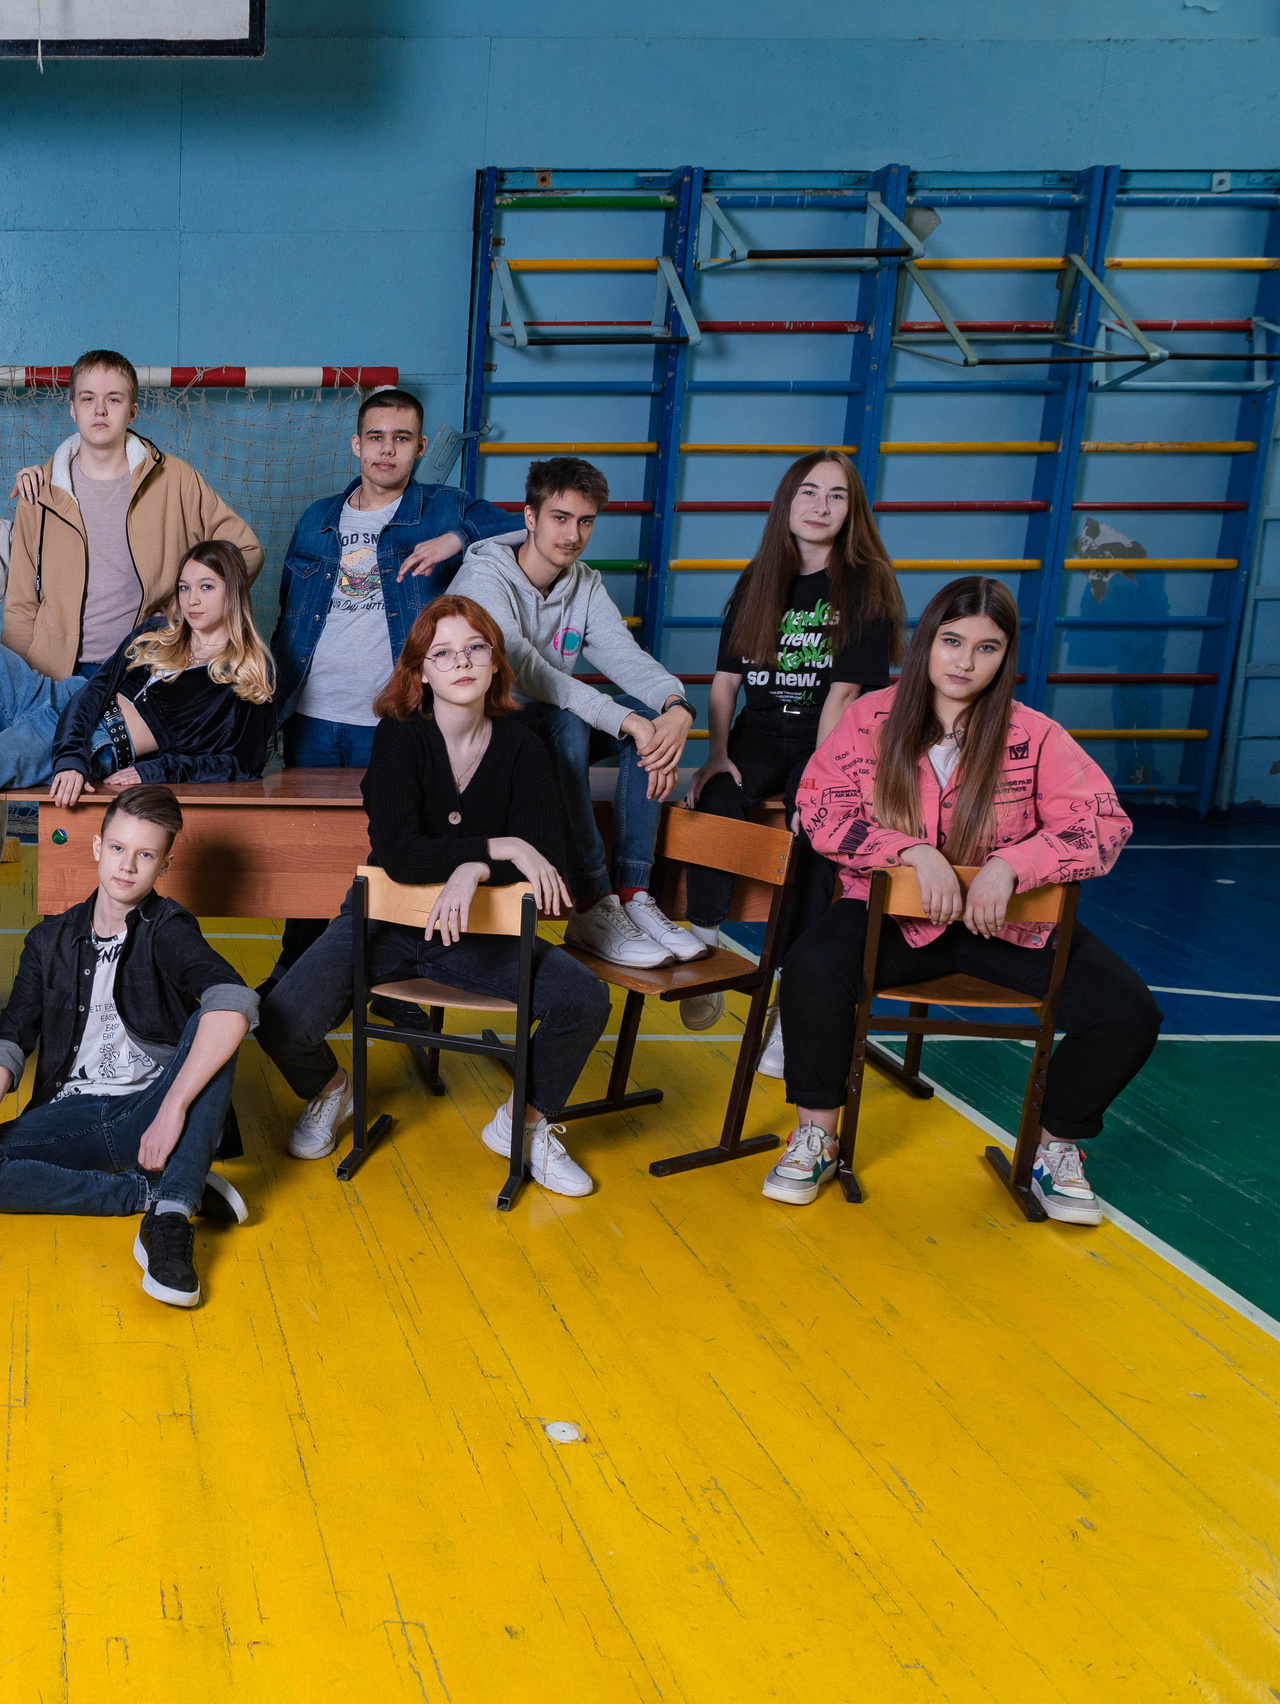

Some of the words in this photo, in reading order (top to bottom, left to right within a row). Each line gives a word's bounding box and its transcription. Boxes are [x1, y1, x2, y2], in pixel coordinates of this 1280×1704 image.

[747, 671, 770, 686] so
[775, 671, 821, 687] new.
[95, 1004, 102, 1012] IT
[101, 1013, 118, 1022] EASY
